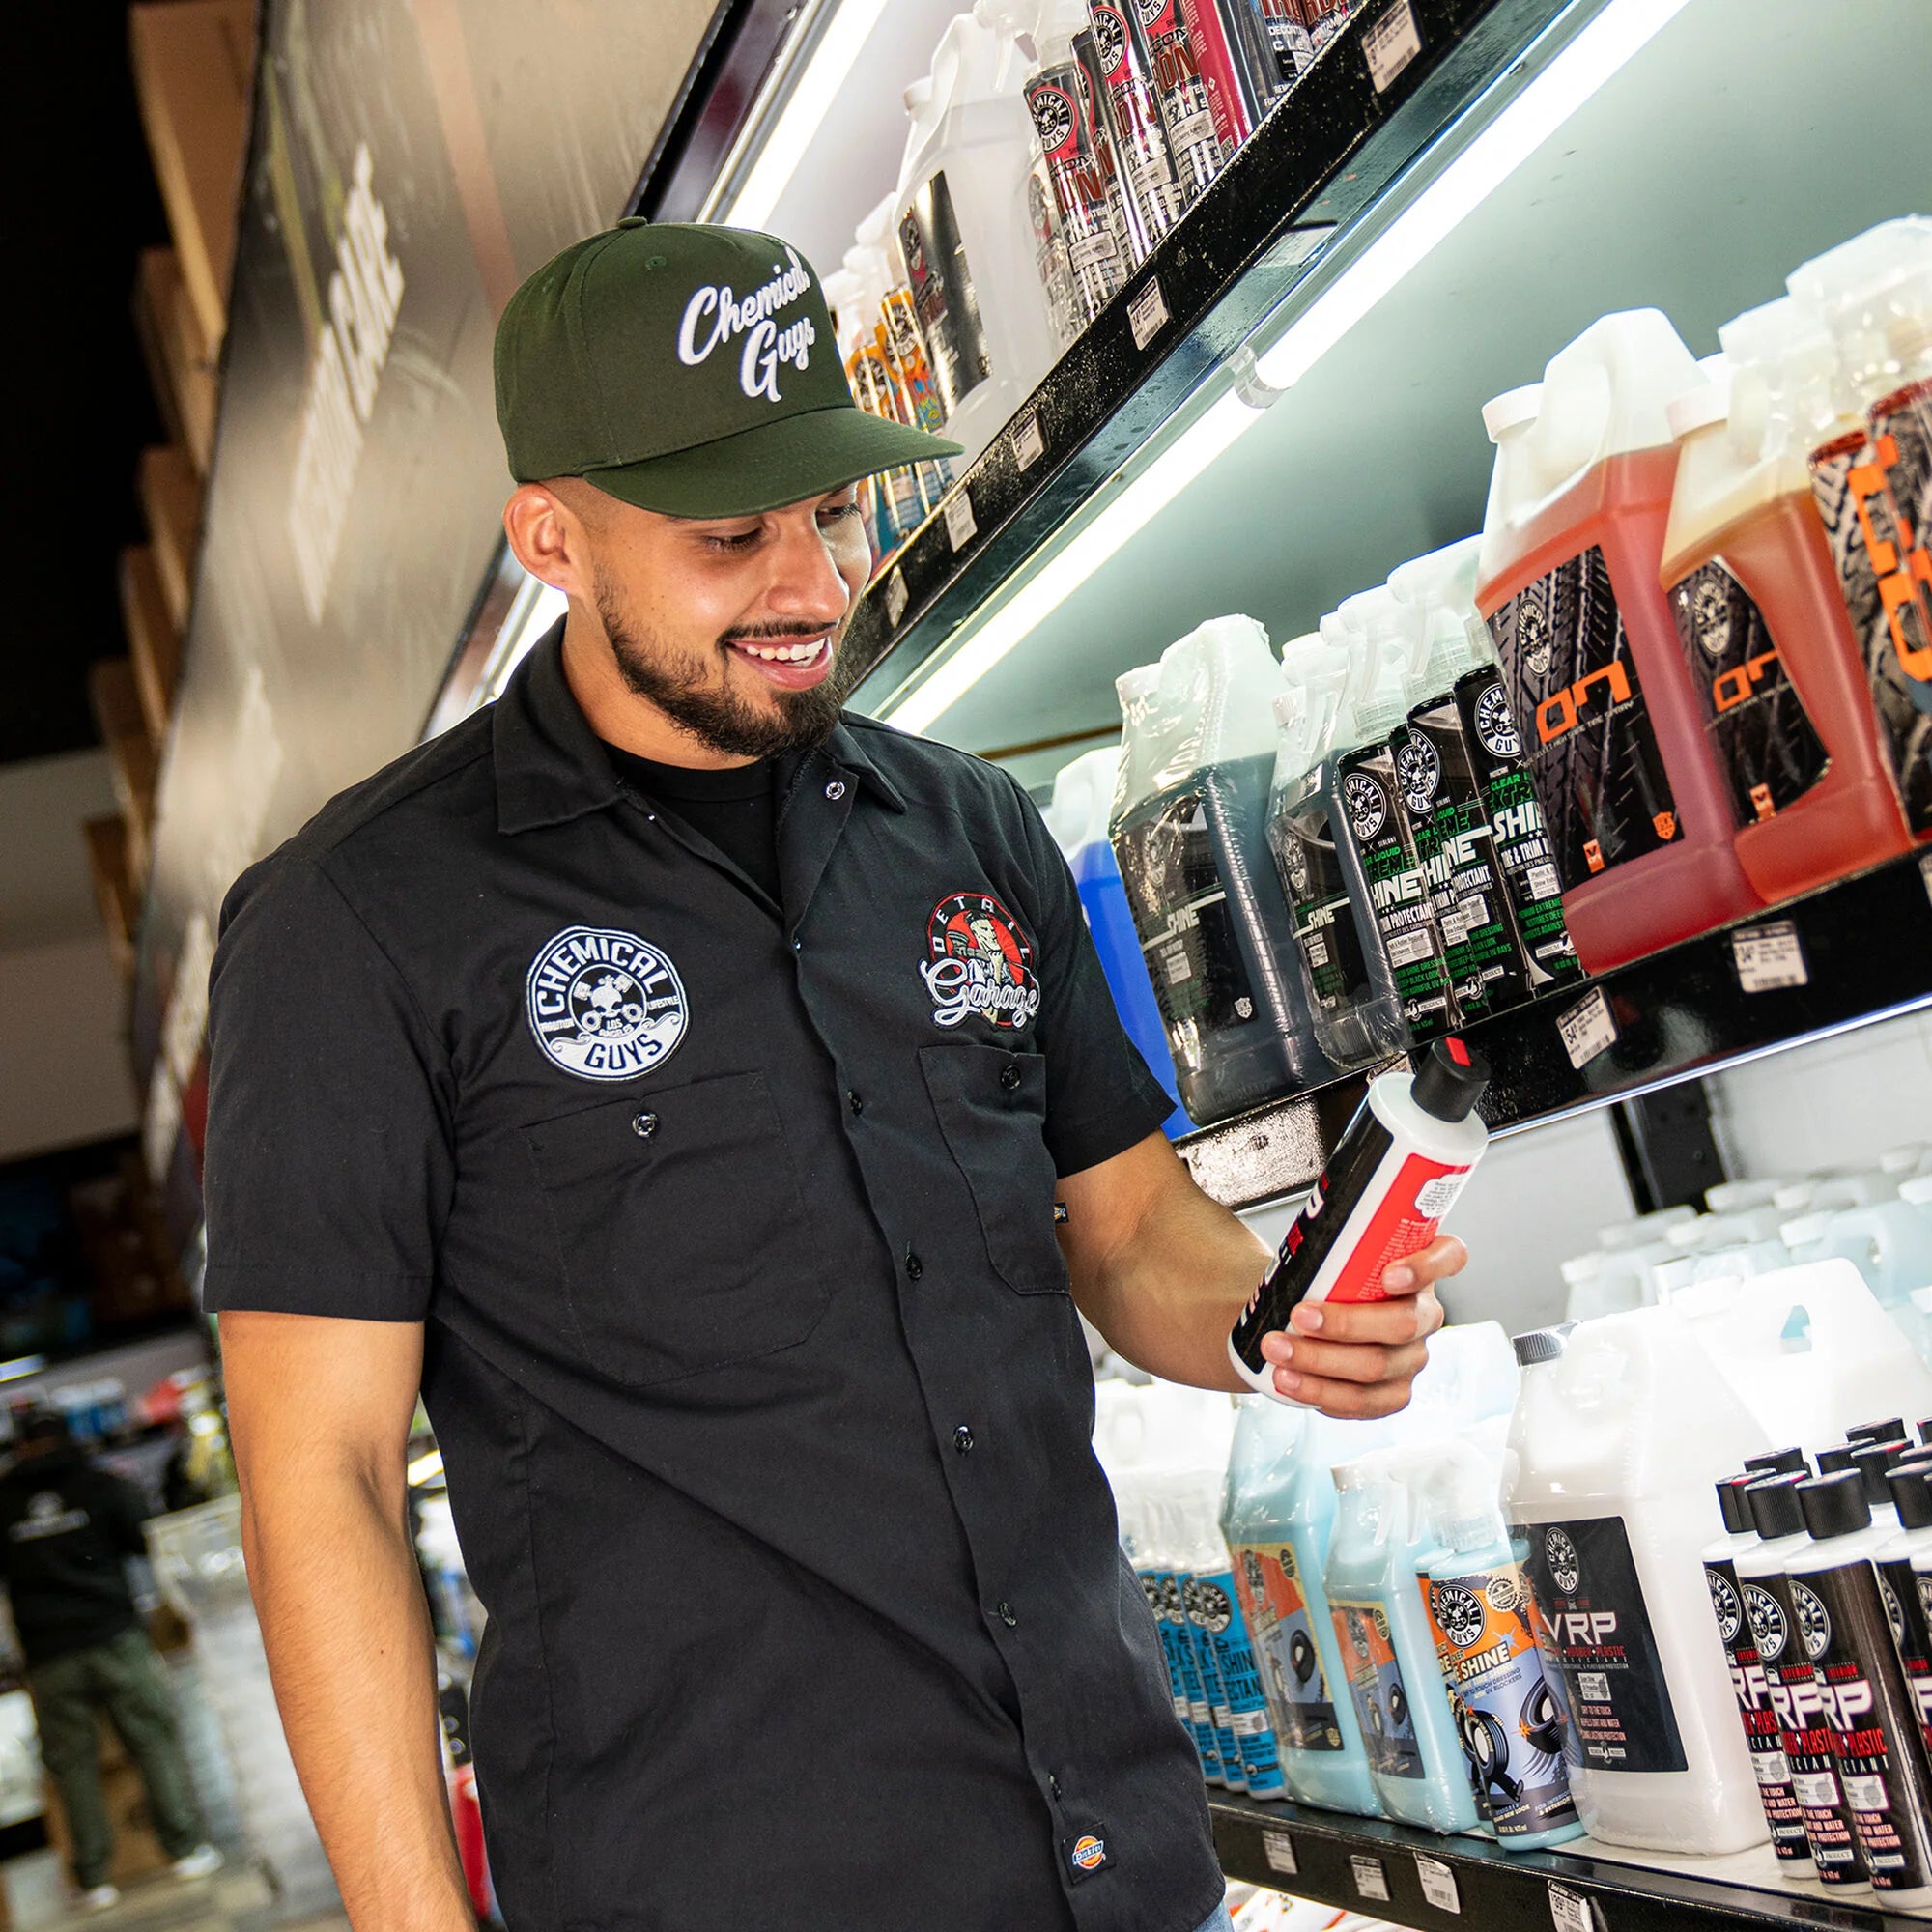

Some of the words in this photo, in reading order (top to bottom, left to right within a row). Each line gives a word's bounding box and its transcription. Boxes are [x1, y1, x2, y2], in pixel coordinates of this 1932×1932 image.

[678, 244, 811, 366] Chemical
[740, 316, 815, 403] Guys
[931, 895, 1032, 960] DETAIL
[535, 935, 669, 1016] CHEMICAL
[919, 957, 1040, 1029] Garage
[583, 1031, 664, 1071] GUYS
[1450, 1627, 1477, 1644] GUYS
[1542, 1611, 1618, 1646] VRP
[1459, 1641, 1511, 1682] SHINE
[1596, 1645, 1627, 1657] PLASTIC
[1845, 1726, 1889, 1758] PLASTIC
